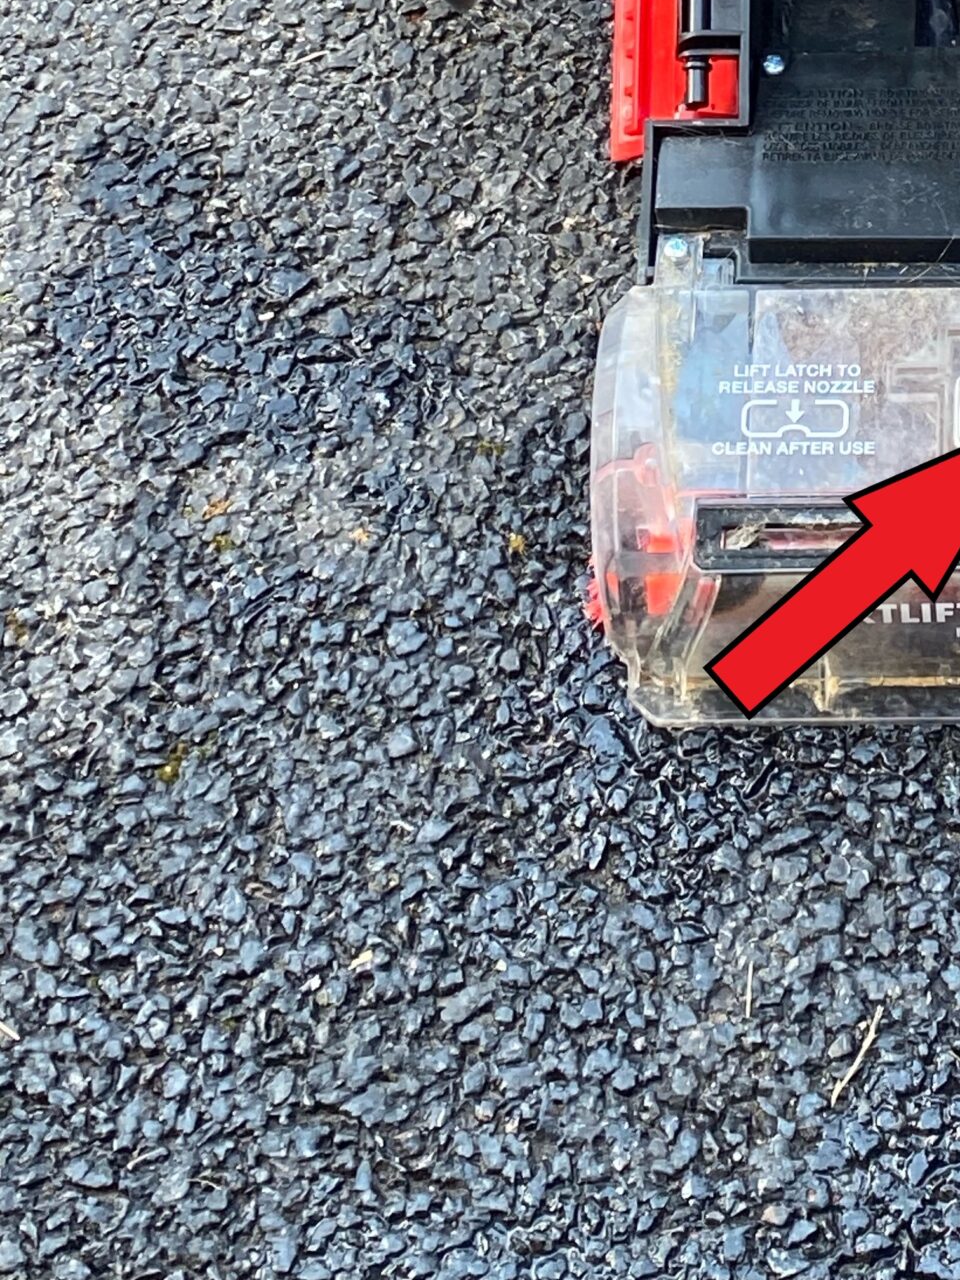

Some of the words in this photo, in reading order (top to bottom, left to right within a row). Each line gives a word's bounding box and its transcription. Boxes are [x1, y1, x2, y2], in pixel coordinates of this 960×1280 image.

[734, 364, 771, 377] LIFT
[775, 364, 832, 377] LATCH
[837, 364, 861, 377] TO
[719, 380, 799, 393] RELEASE
[804, 380, 875, 393] NOZZLE
[712, 441, 771, 455] CLEAN
[776, 441, 834, 455] AFTER
[839, 441, 875, 455] USE
